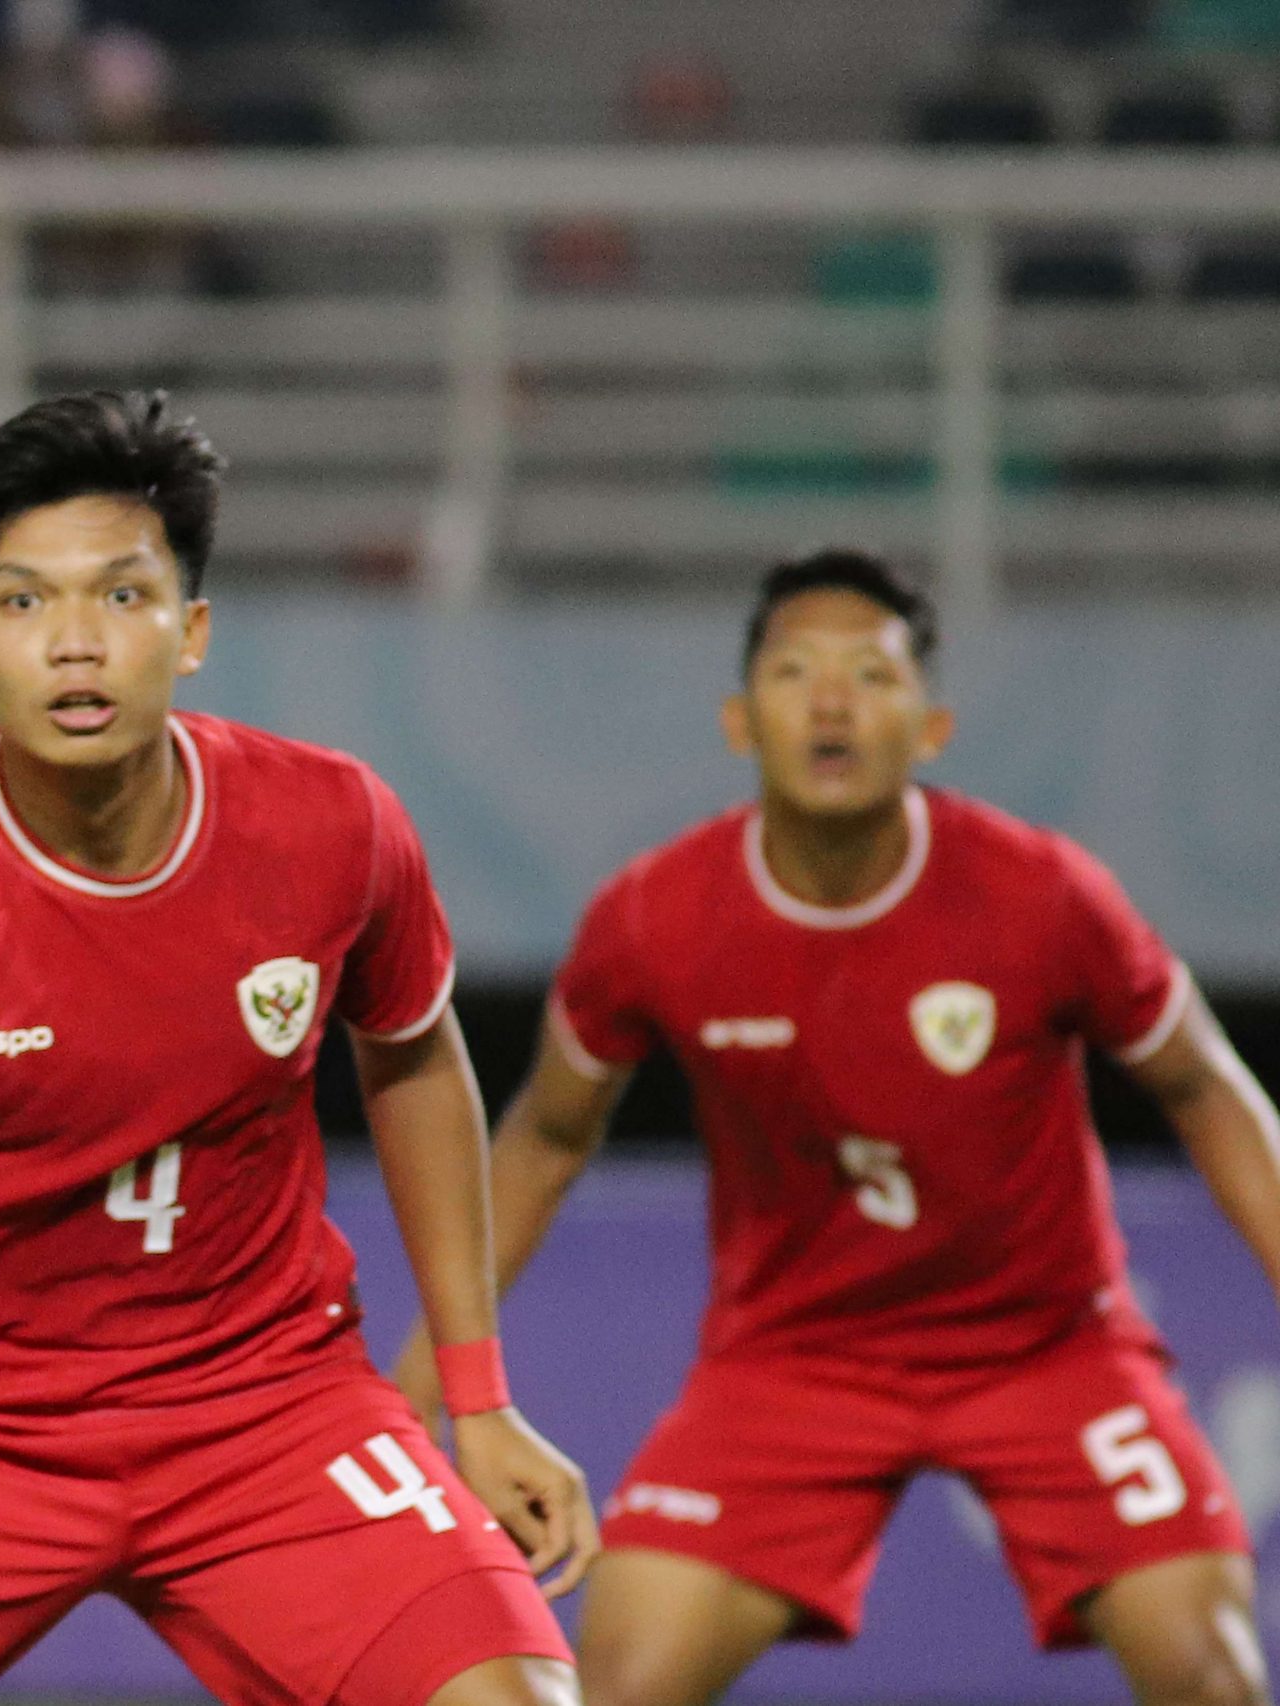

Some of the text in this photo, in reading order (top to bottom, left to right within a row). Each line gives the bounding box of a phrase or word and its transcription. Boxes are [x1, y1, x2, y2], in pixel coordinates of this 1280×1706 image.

[105, 1144, 185, 1253] 4
[839, 1138, 917, 1229] 5
[326, 1433, 457, 1533] 4
[1082, 1406, 1187, 1525] 5
